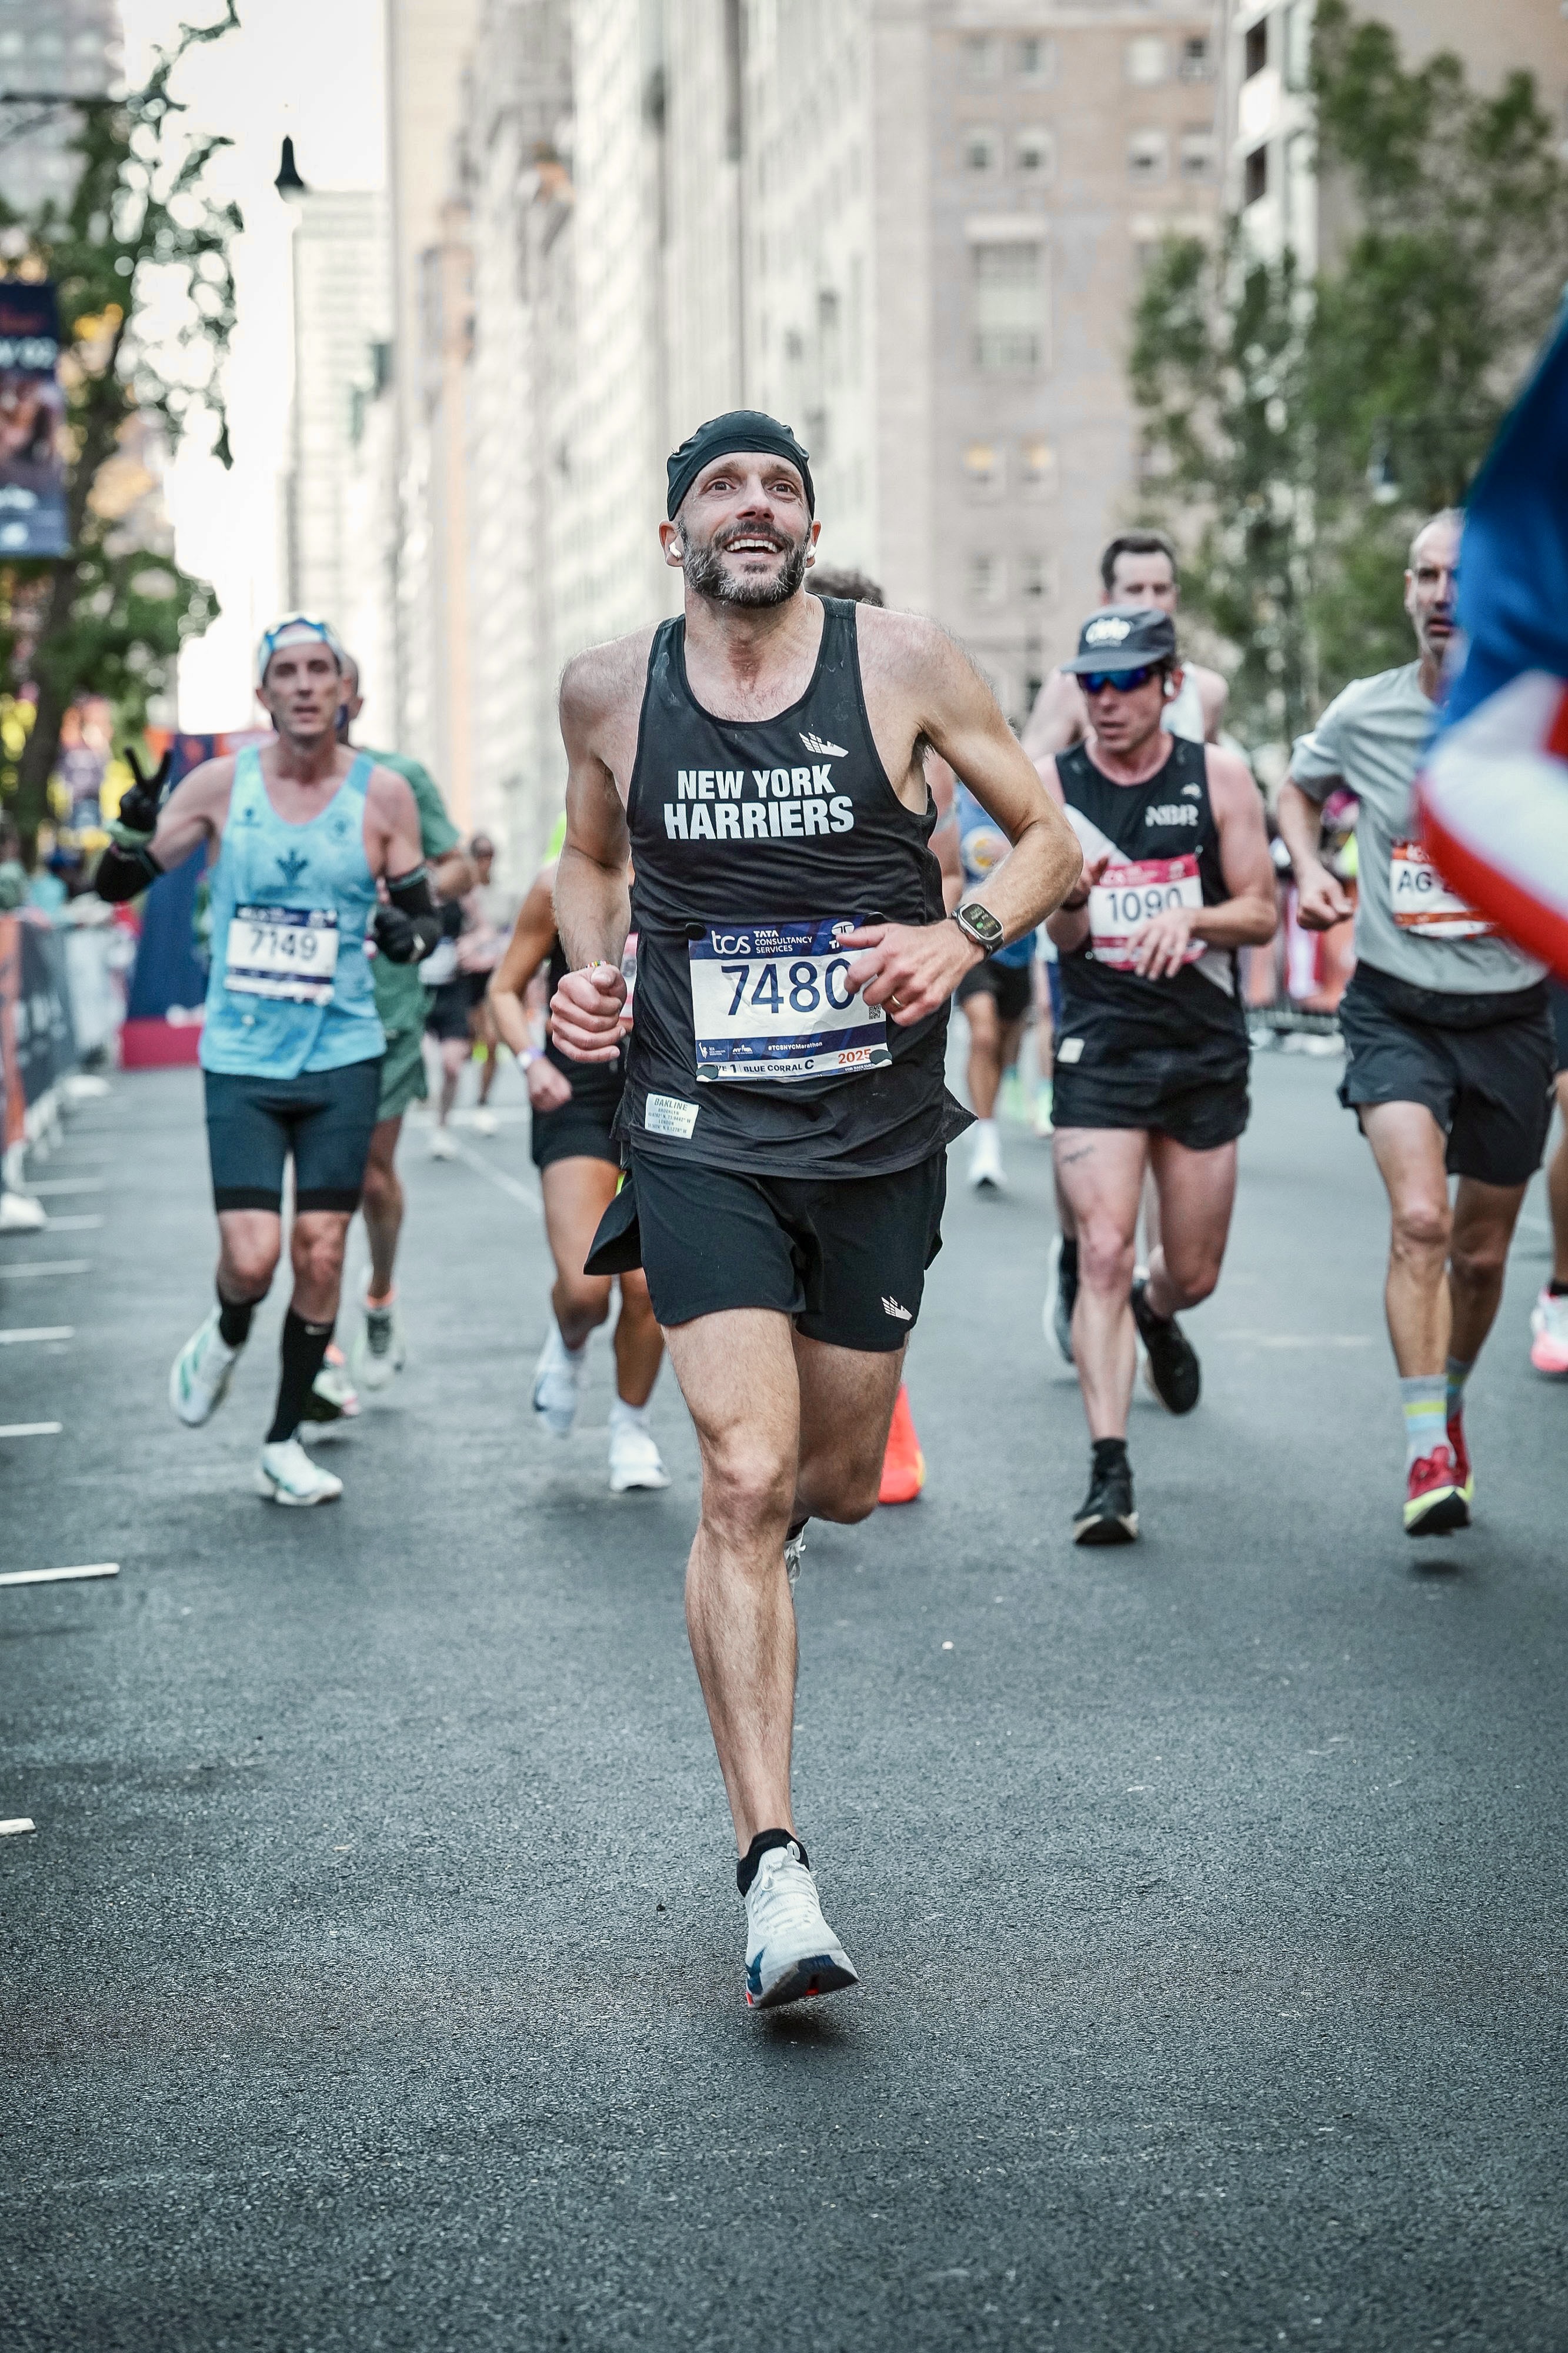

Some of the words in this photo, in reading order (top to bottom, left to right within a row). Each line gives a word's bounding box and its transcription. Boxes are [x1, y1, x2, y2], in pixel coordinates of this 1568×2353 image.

[678, 770, 744, 799] NEW
[752, 764, 836, 798] YORK
[663, 795, 854, 839] HARRIERS
[251, 926, 318, 961] 7149
[711, 930, 751, 954] tcs
[755, 936, 812, 946] CONSULTANCY
[756, 945, 793, 954] SERVICES
[721, 958, 855, 1016] 7480
[730, 1064, 736, 1073] 1
[768, 1064, 802, 1072] CORRAL
[805, 1059, 814, 1070] C
[838, 1048, 871, 1064] 2025
[655, 1098, 688, 1111] BAKLINE
